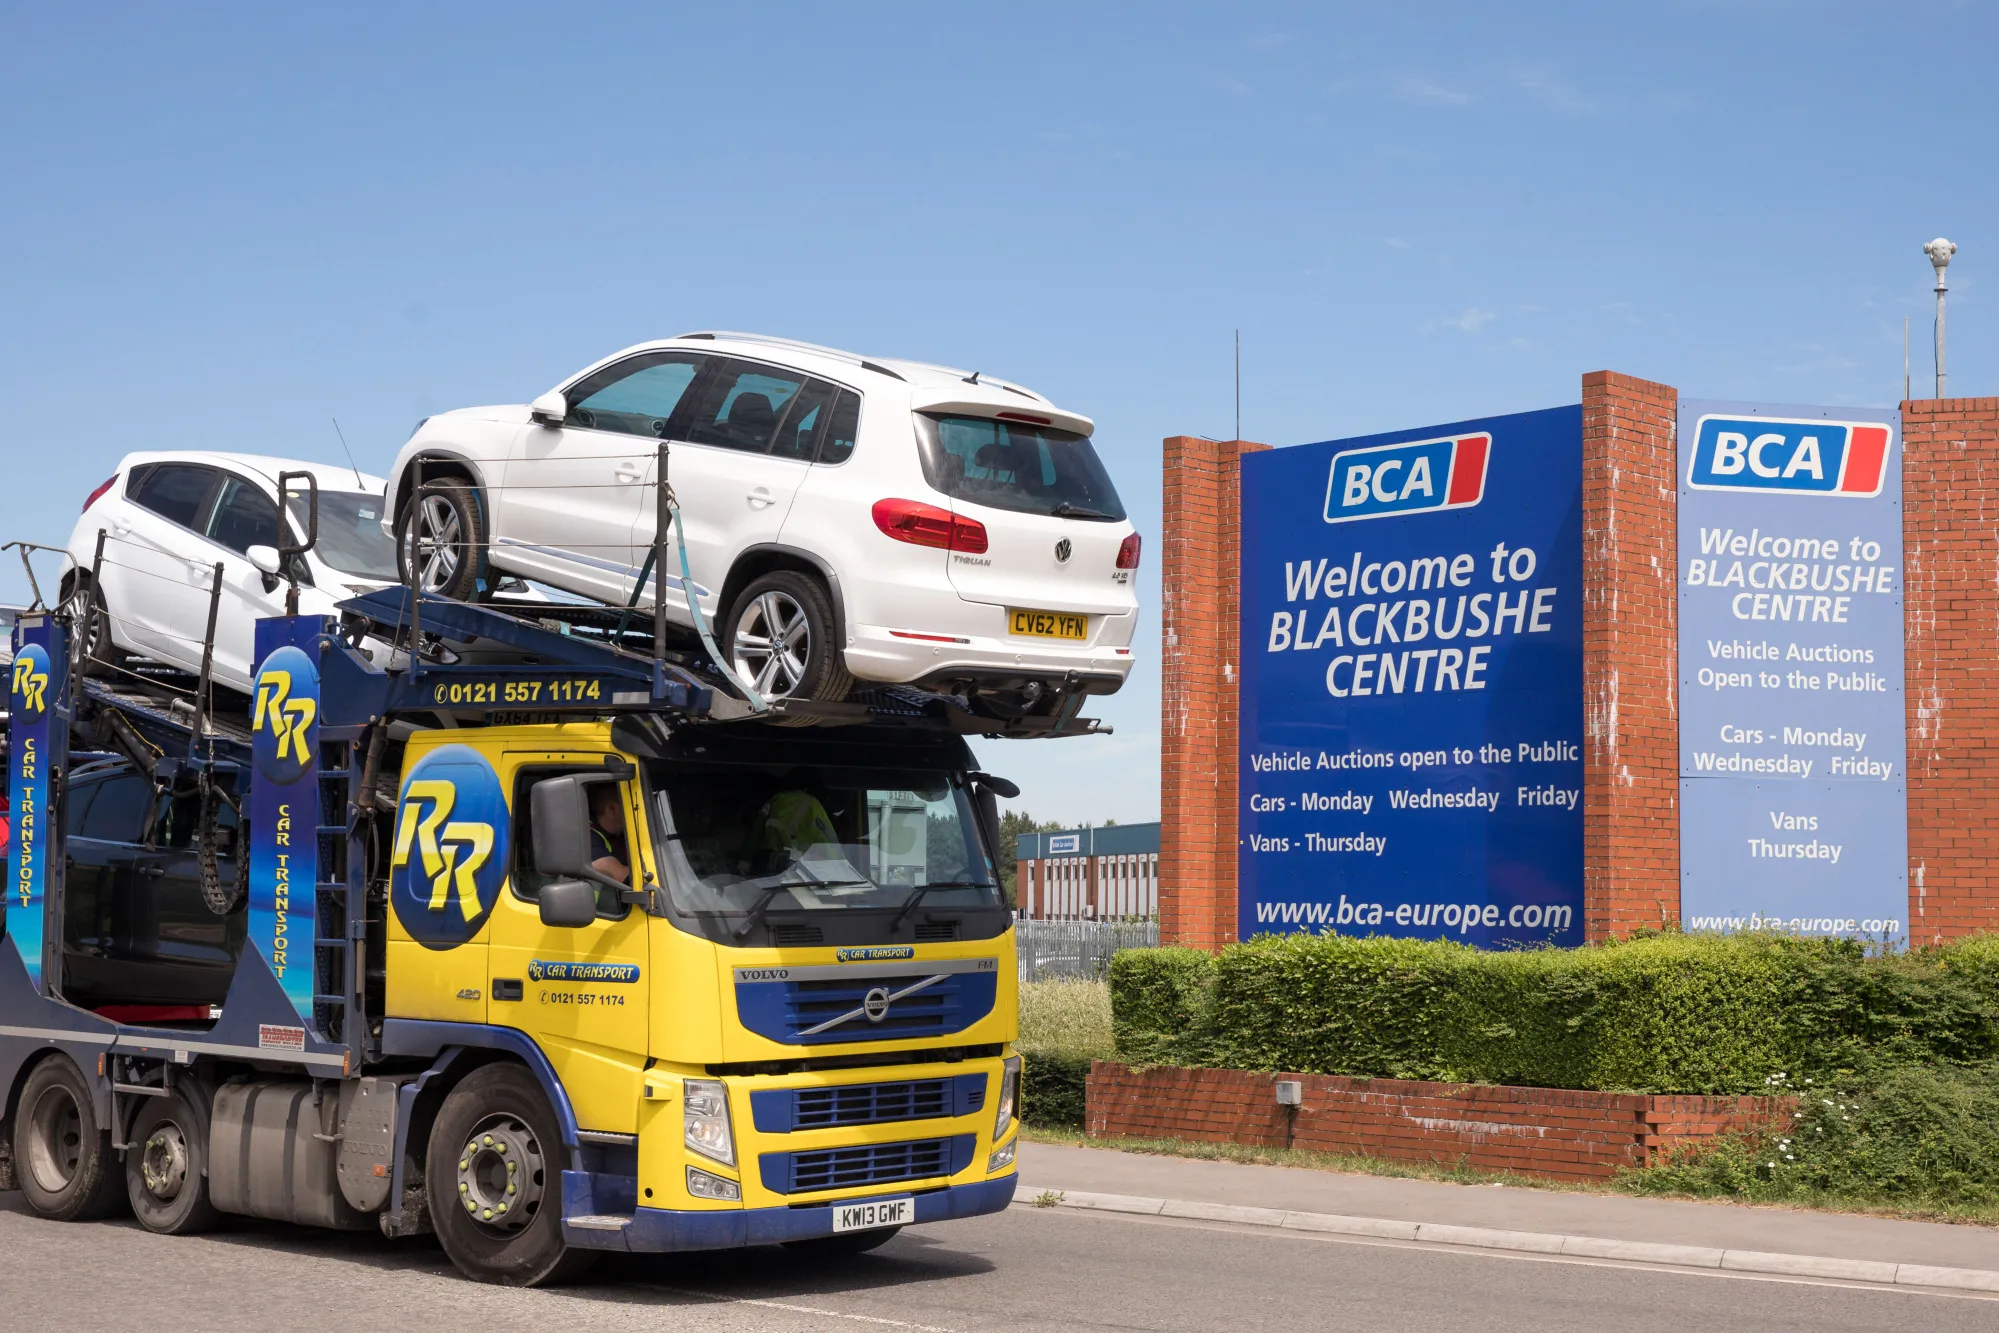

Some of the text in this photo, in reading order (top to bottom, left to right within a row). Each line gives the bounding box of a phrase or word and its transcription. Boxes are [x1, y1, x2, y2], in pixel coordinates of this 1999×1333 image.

[1711, 432, 1824, 480] BCA
[1342, 456, 1434, 507] BCA
[1700, 528, 1881, 562] Welcome to
[954, 555, 991, 567] TIGUAN
[1285, 541, 1537, 602] Welcome to
[1687, 559, 1895, 593] BLACKBUSHE
[1267, 587, 1557, 653] BLACKBUSHE
[1732, 593, 1851, 623] CENTRE
[1015, 612, 1084, 637] CV62 YFN
[1707, 639, 1874, 663] Vehicle Auctions
[1326, 645, 1492, 698] CENTRE
[1698, 668, 1886, 692] Open to the Public
[12, 658, 48, 713] RR
[450, 680, 600, 703] 0121 557 1174
[253, 670, 316, 765] RR
[1720, 725, 1763, 744] Cars
[1783, 727, 1866, 751] Monday
[1251, 740, 1579, 772] Vehicle Auctions open to the Public
[1693, 752, 1893, 781] Wednesday Friday
[1250, 793, 1285, 812] Cars
[1301, 791, 1373, 815] Monday
[1389, 787, 1500, 812] Wednesday
[1517, 784, 1579, 810] Friday
[19, 738, 35, 908] CAR TRANSPORT
[1770, 812, 1818, 830] Vans
[393, 780, 495, 923] RR
[1250, 834, 1289, 852] Vans
[1305, 832, 1386, 856] Thursday
[1748, 839, 1842, 864] Thursday
[273, 804, 290, 979] CAR TRANSPORT
[1256, 895, 1572, 934] www.bca-europe.com
[1691, 912, 1900, 935] wwwbca-europe.com
[850, 950, 866, 959] CAR
[868, 948, 910, 958] TRANSPORT
[977, 960, 993, 970] FM
[547, 964, 567, 977] CAR
[571, 966, 634, 979] TRANSPORT
[740, 969, 789, 980] VOLVO
[456, 988, 481, 1001] 420
[551, 992, 625, 1006] 0121 557 1174
[842, 1202, 906, 1228] KW13 GWF
